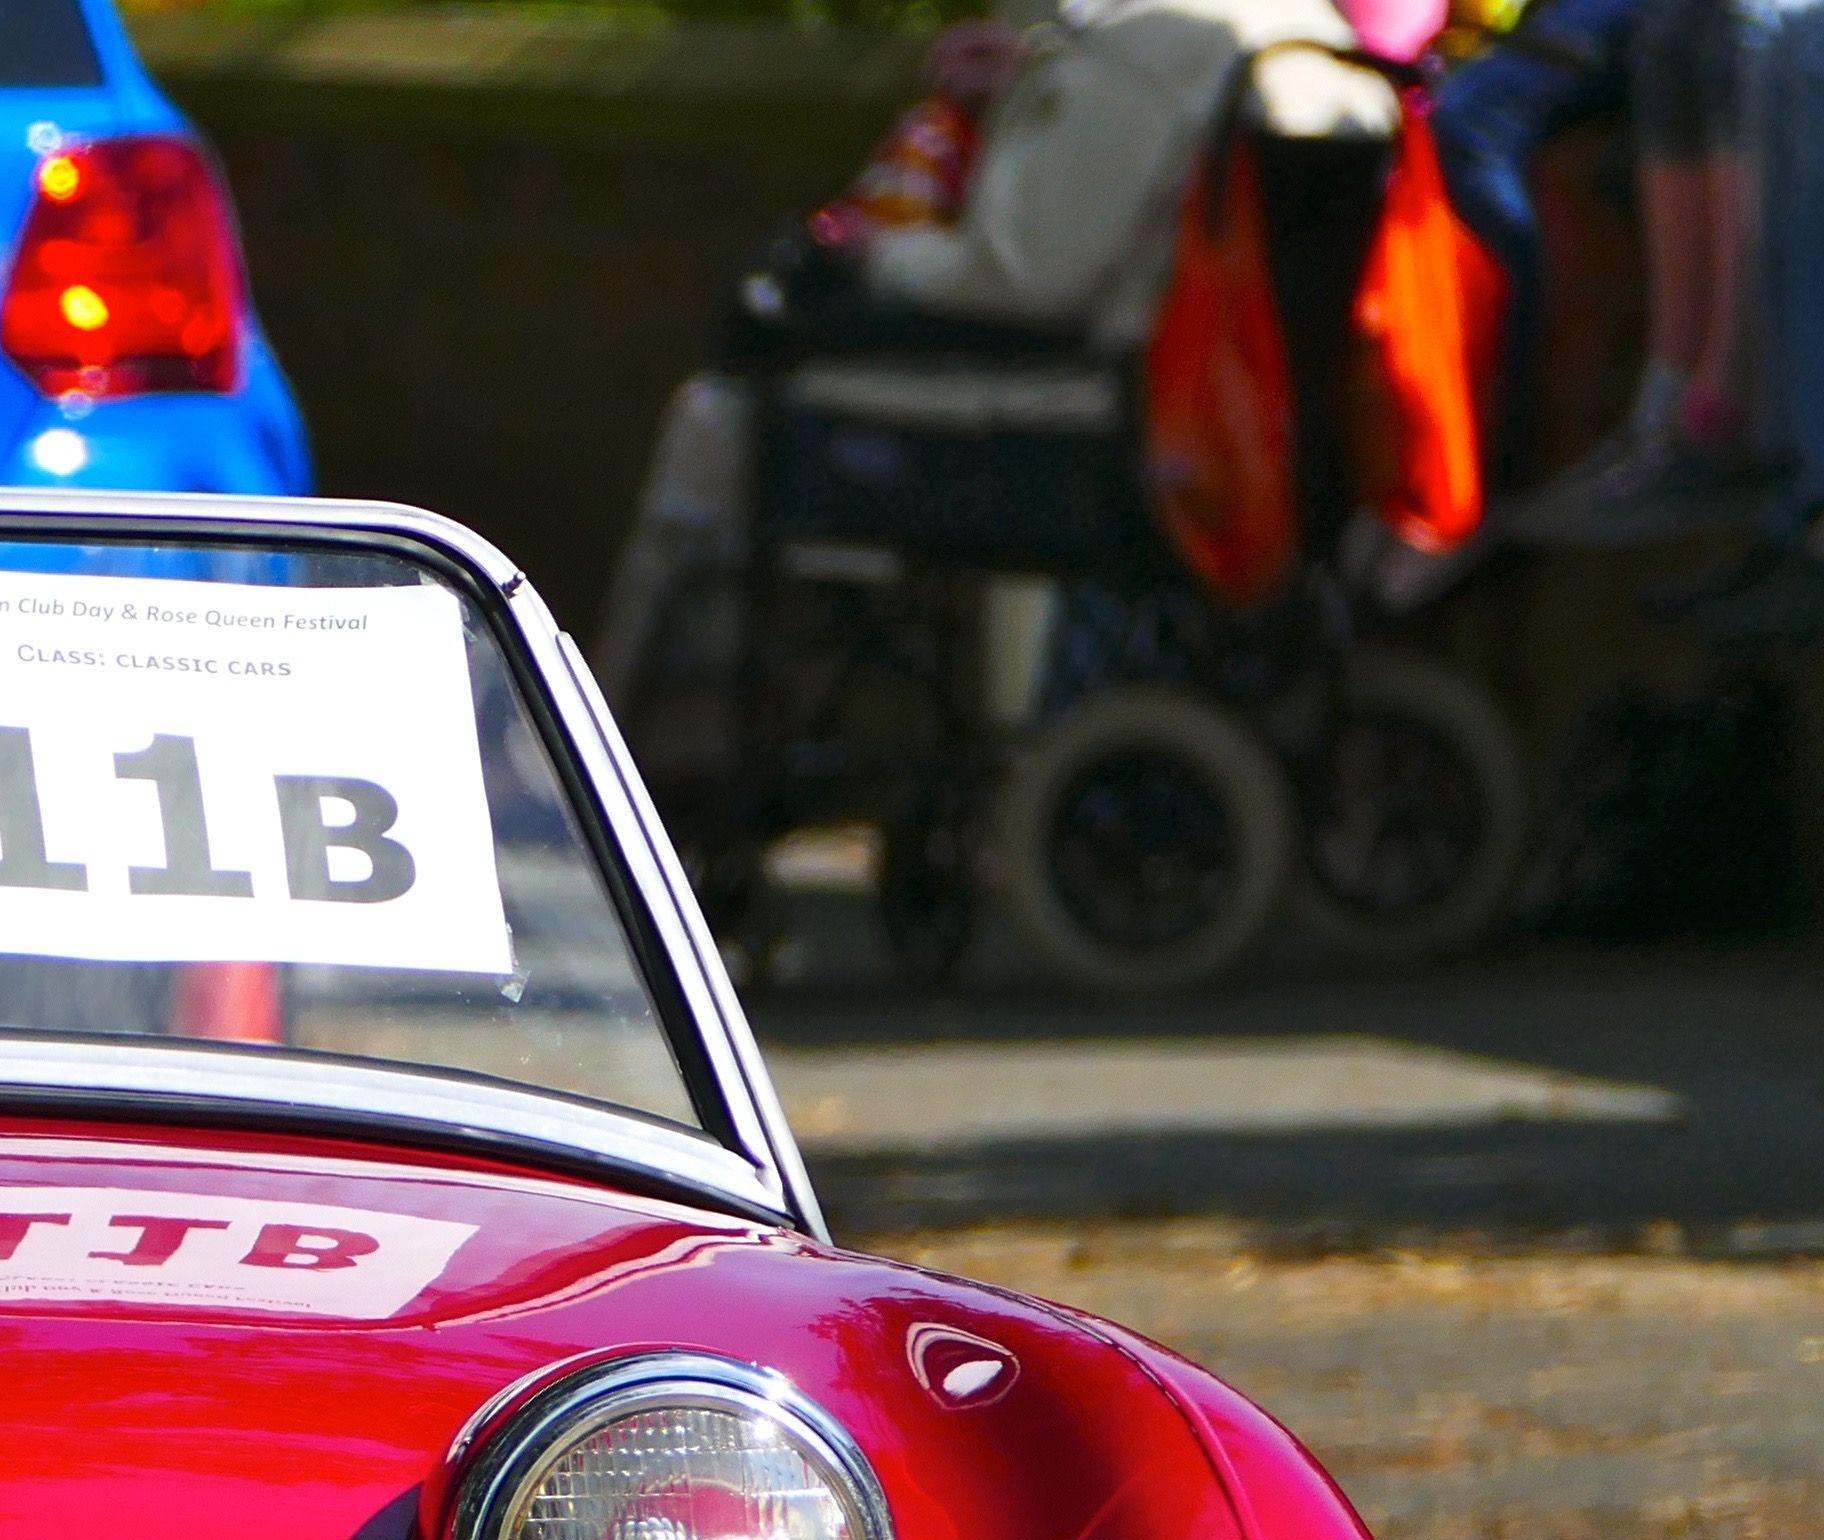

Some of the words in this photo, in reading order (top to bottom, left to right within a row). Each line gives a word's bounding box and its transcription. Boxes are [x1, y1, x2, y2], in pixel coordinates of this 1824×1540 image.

[18, 598, 64, 615] Club
[73, 601, 114, 622] Day
[121, 603, 138, 620] &
[147, 606, 197, 624] Rose
[205, 610, 275, 629] Queen
[284, 614, 368, 630] Festival
